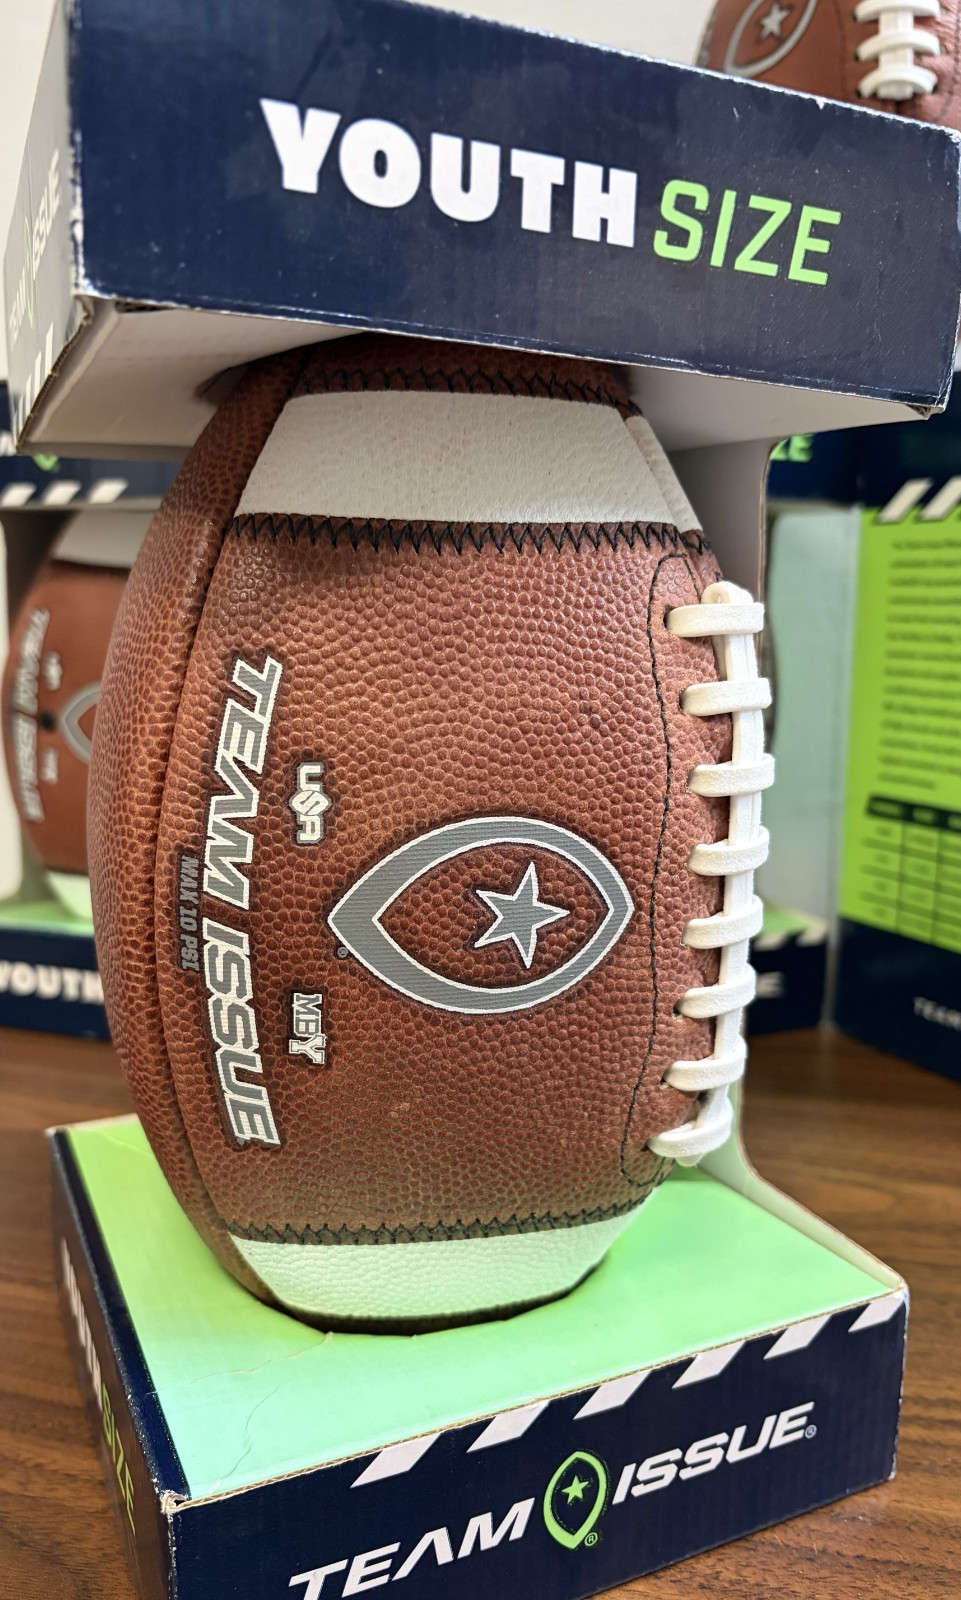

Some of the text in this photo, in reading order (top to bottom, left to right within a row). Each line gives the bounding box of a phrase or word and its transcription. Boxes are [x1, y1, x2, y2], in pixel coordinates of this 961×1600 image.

[261, 99, 842, 286] YOUTH SIZE
[291, 762, 332, 844] USA
[179, 854, 200, 972] MAX 10 PSI
[202, 656, 283, 1145] TEAM ISSUE
[288, 992, 326, 1065] MBY
[101, 1383, 136, 1536] SIZE
[288, 1497, 536, 1600] TEAM
